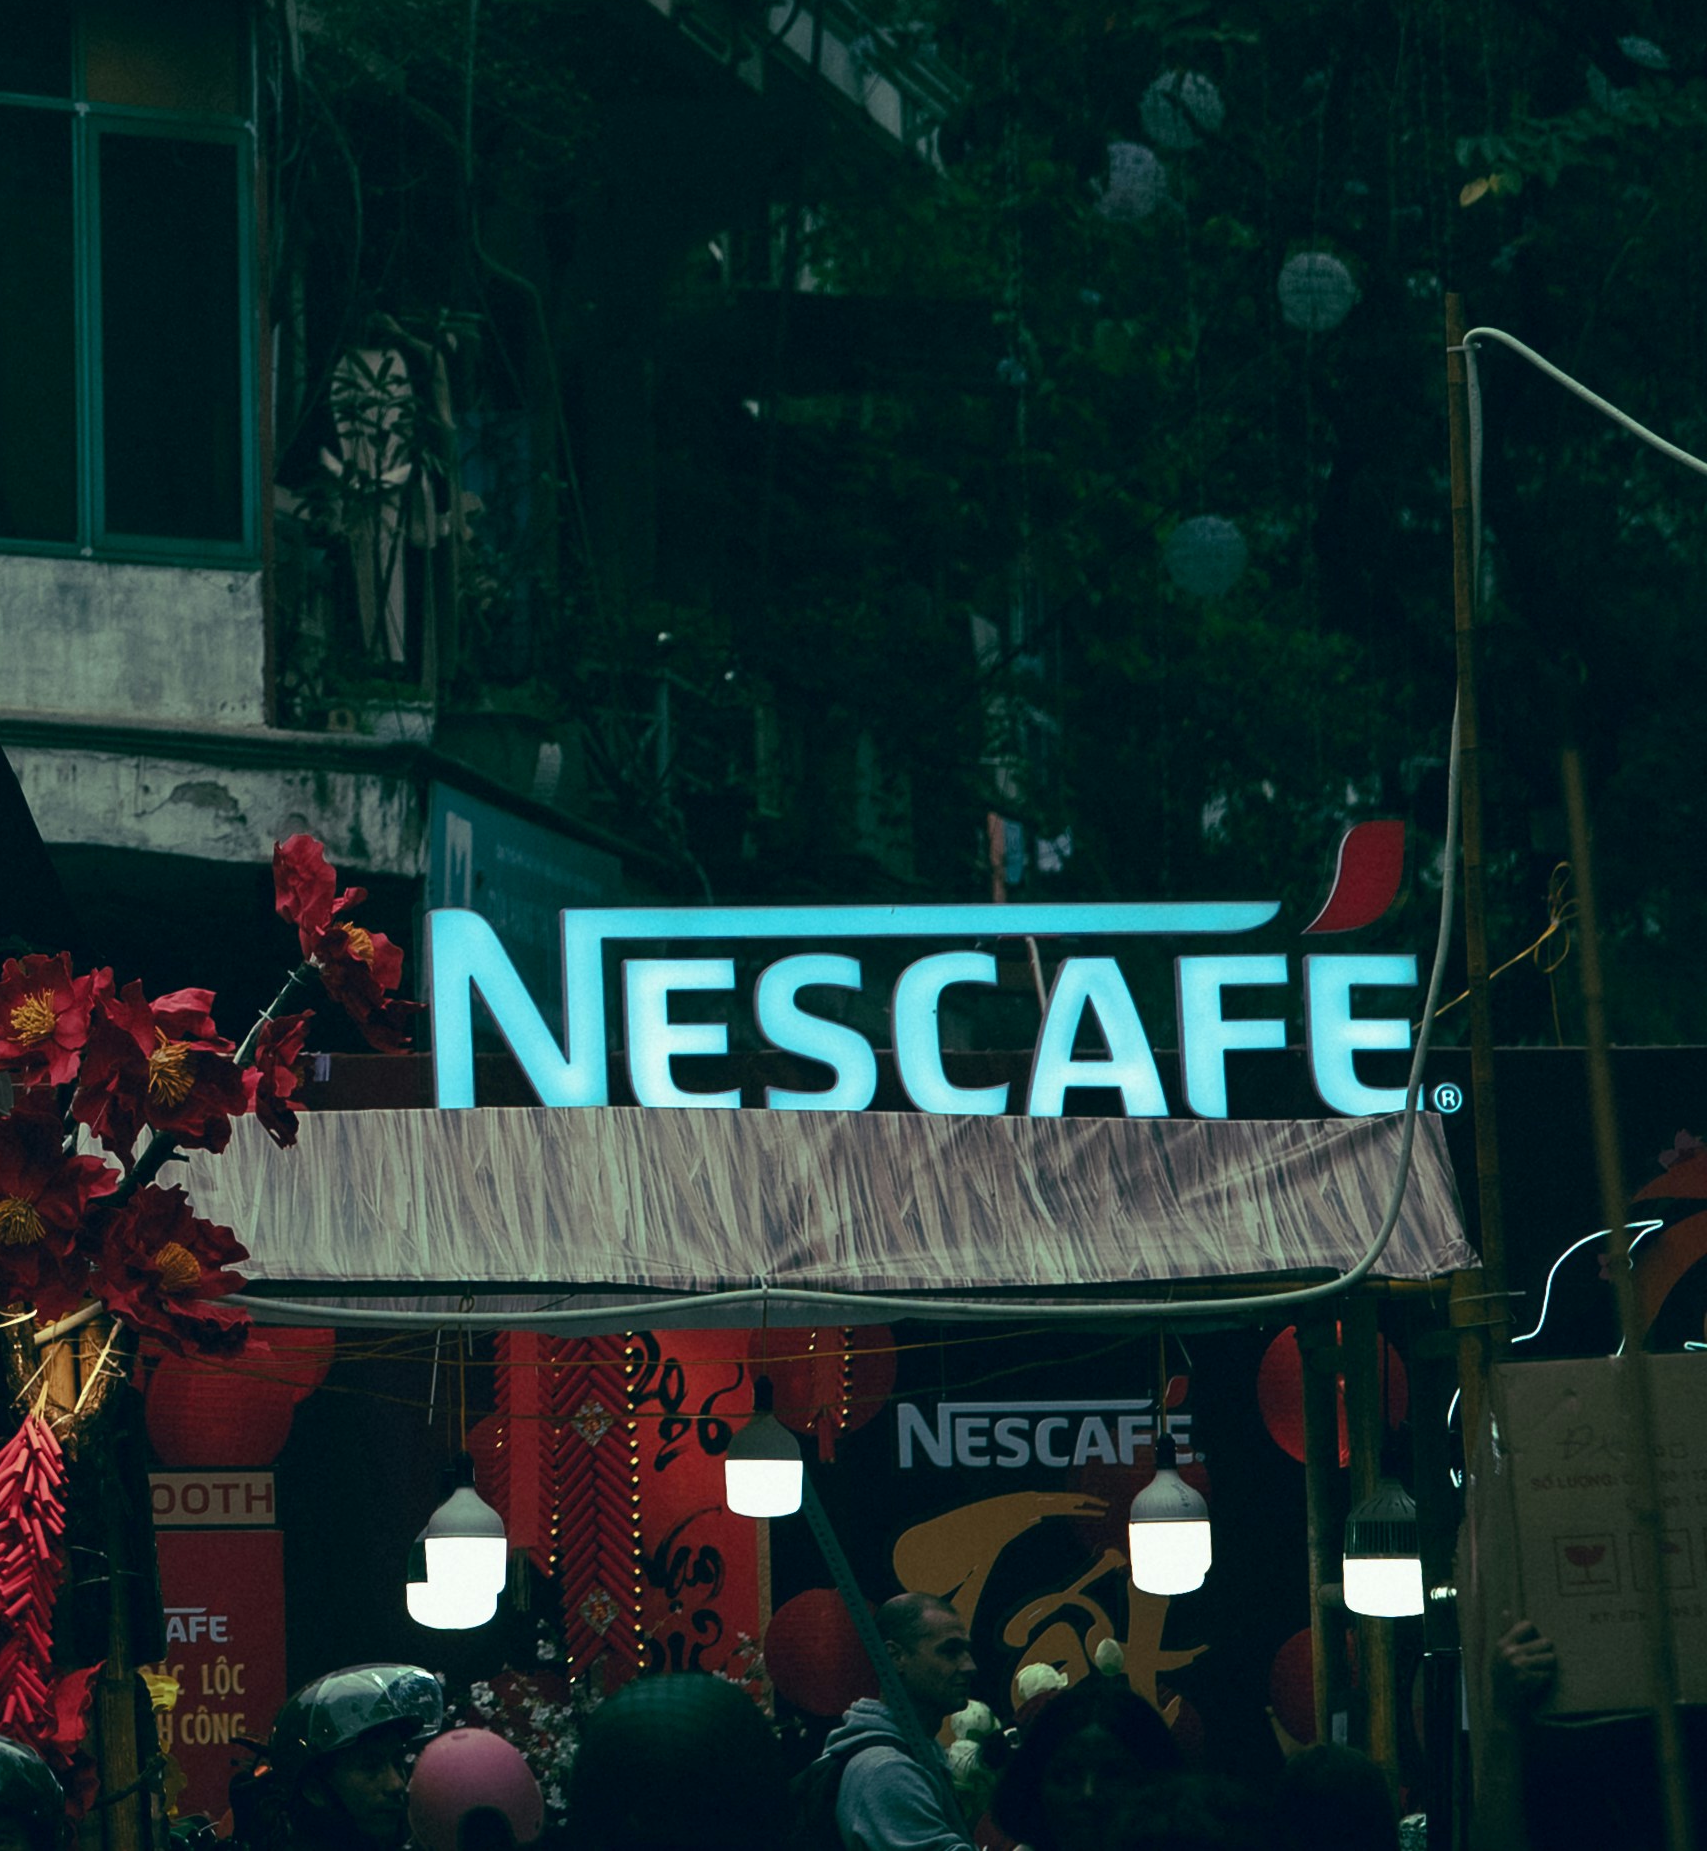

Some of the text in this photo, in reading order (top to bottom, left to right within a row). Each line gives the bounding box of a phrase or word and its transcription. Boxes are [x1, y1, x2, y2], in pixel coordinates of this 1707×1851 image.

[150, 1483, 273, 1515] OOTH
[201, 1655, 245, 1701] LỘC
[181, 1706, 246, 1745] CÔNG
